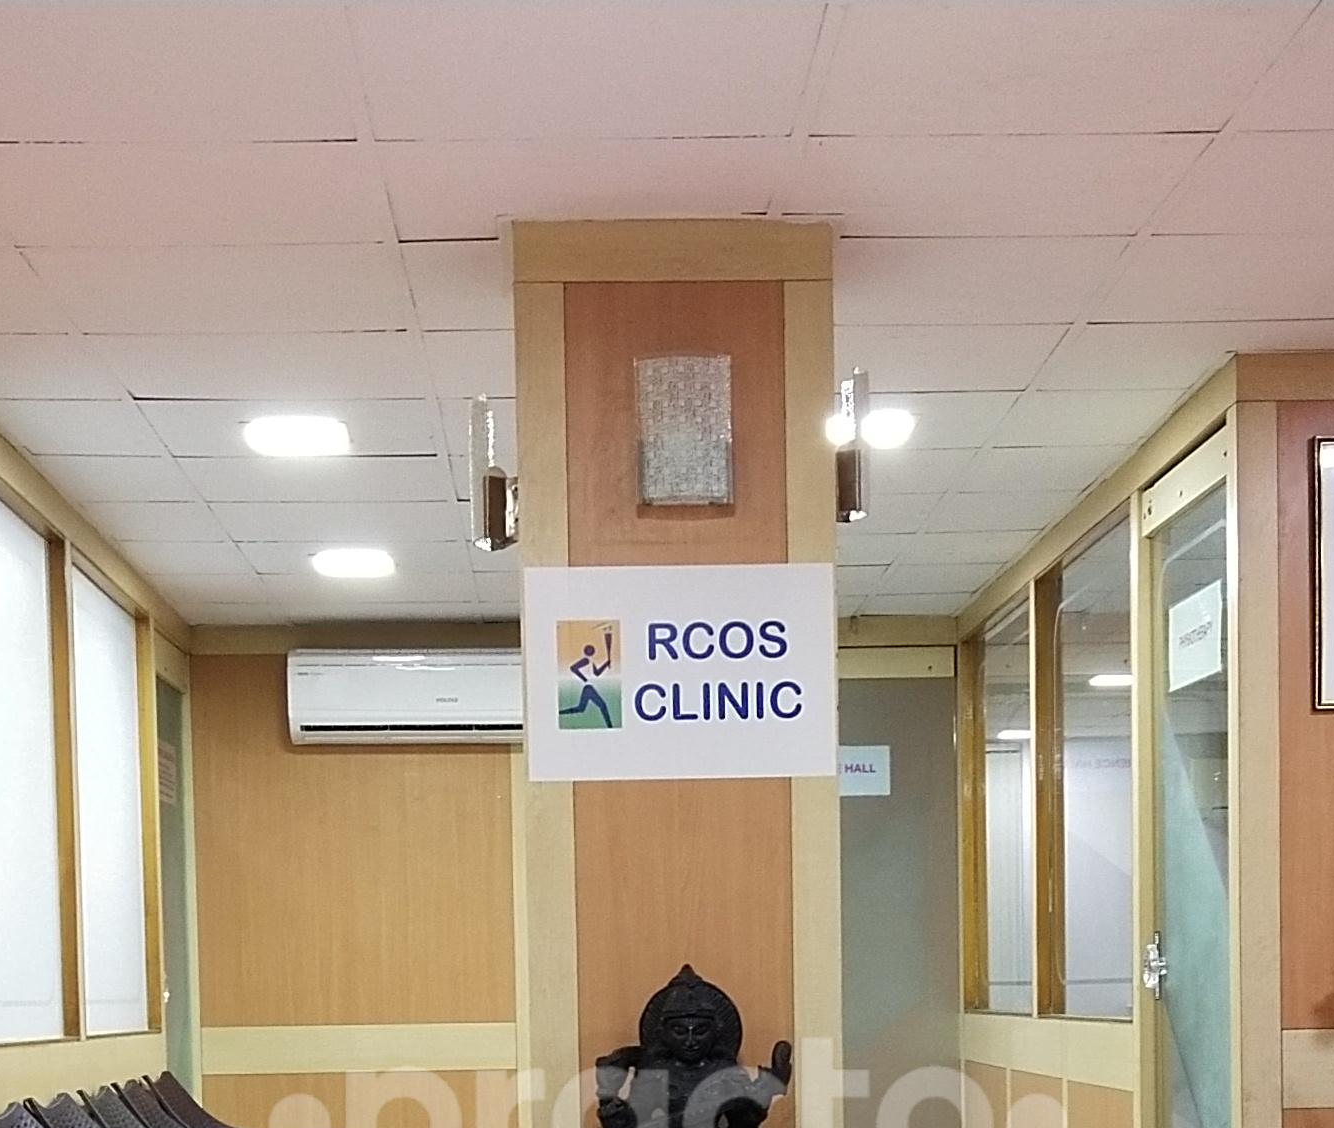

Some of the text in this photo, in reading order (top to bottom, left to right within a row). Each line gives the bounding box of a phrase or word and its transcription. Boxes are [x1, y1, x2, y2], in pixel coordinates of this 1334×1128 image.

[647, 620, 788, 660] RCOS
[634, 681, 802, 721] CLINIC
[843, 763, 876, 774] HALL
